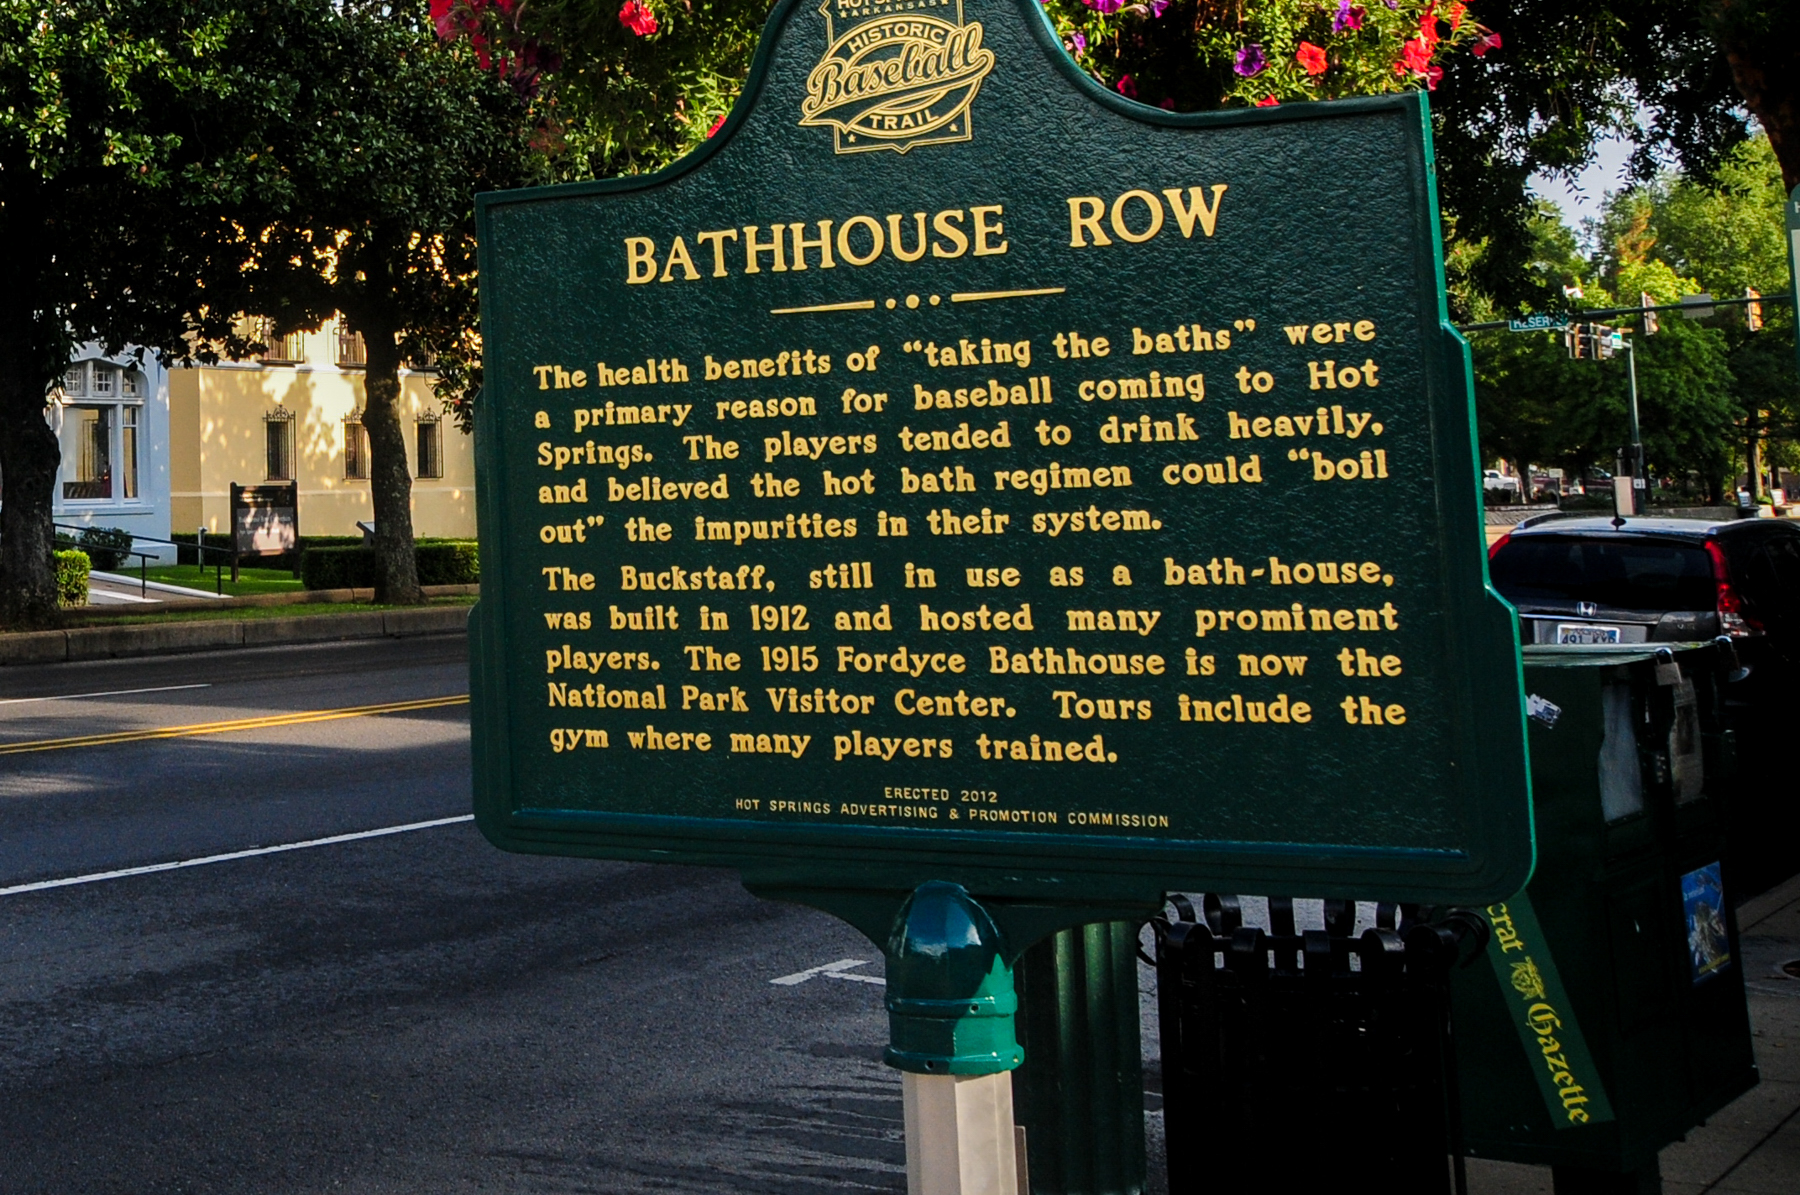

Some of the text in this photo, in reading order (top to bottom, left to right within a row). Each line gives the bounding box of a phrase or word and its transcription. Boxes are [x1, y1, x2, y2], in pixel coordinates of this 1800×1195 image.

[851, 0, 937, 18] ARKANSAS
[847, 23, 946, 54] HISTORIC
[802, 21, 984, 114] Baseball
[869, 109, 940, 130] TRAIL
[624, 183, 1229, 285] BATHHOUSE ROW
[533, 318, 1376, 391] The health benefits of “taking the baths” were
[534, 358, 1380, 433] a primary reason for baseball coming to Hot
[537, 404, 1384, 471] Springs. The players tended to drink heavily,
[538, 447, 1389, 504] and believed the hot bath regimen could “boil
[539, 504, 1163, 546] out” the impurities in their system.
[541, 556, 1394, 593] The Buckstaff, still in use as a bath-house,
[544, 601, 1399, 638] was built in 1912 and hosted many prominent
[545, 644, 1403, 678] players. The 1915 Fordyce Bathhouse is now the
[548, 681, 1407, 726] National Park Visitor Center. Tours include the
[549, 724, 1118, 763] gym where many players trained.
[735, 798, 1169, 828] HOT SPRINGS ADVERTISING & PROMOTION COMMISSION
[884, 786, 998, 804] ERECTED 2012
[1525, 1002, 1590, 1125] Gazette
